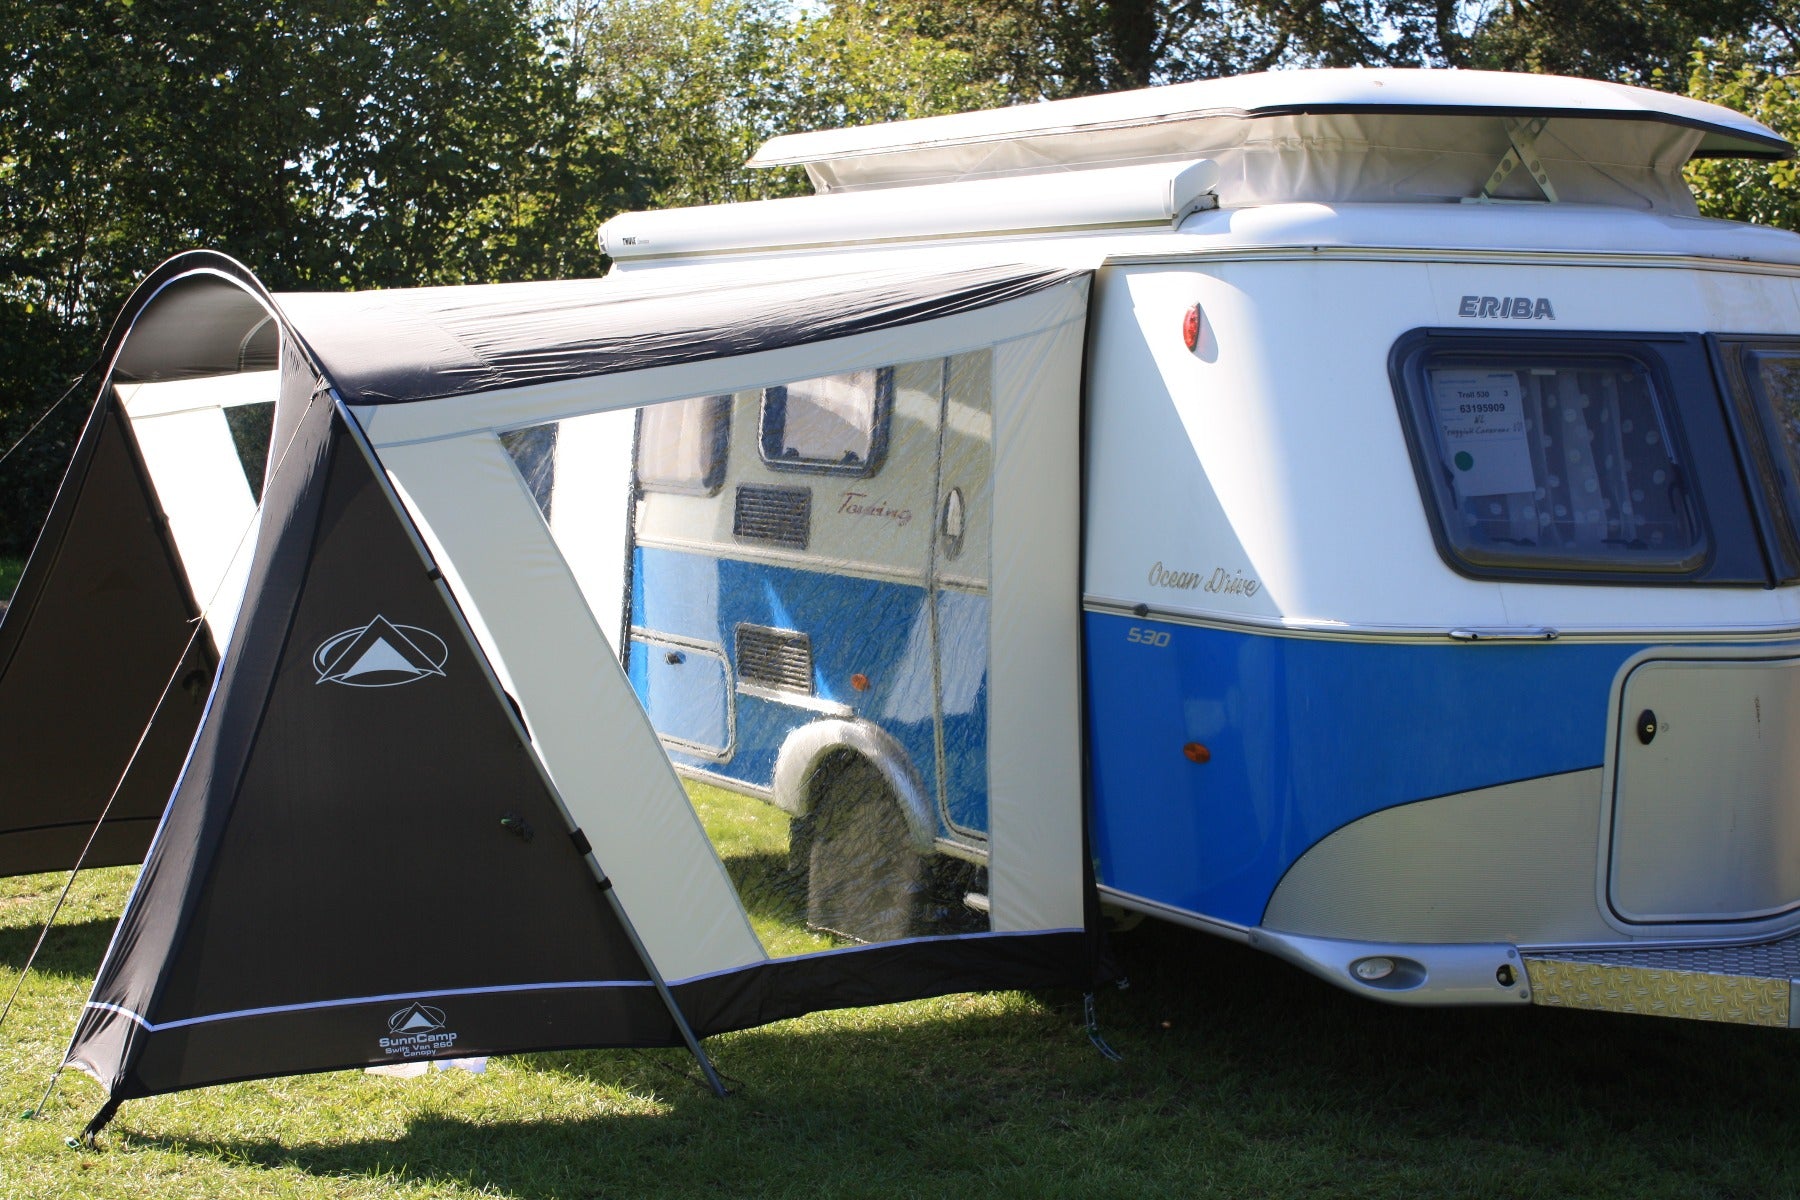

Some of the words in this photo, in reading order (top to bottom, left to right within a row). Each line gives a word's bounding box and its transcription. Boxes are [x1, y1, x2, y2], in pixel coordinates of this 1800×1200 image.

[1458, 295, 1556, 320] ERIBA
[1460, 403, 1505, 413] 63195909
[1148, 561, 1203, 590] Ocean
[1204, 567, 1262, 597] Drive
[1127, 627, 1171, 648] 530
[379, 1032, 457, 1047] SunnCamp
[385, 1046, 410, 1054] Swift
[403, 1049, 437, 1057] Canopy
